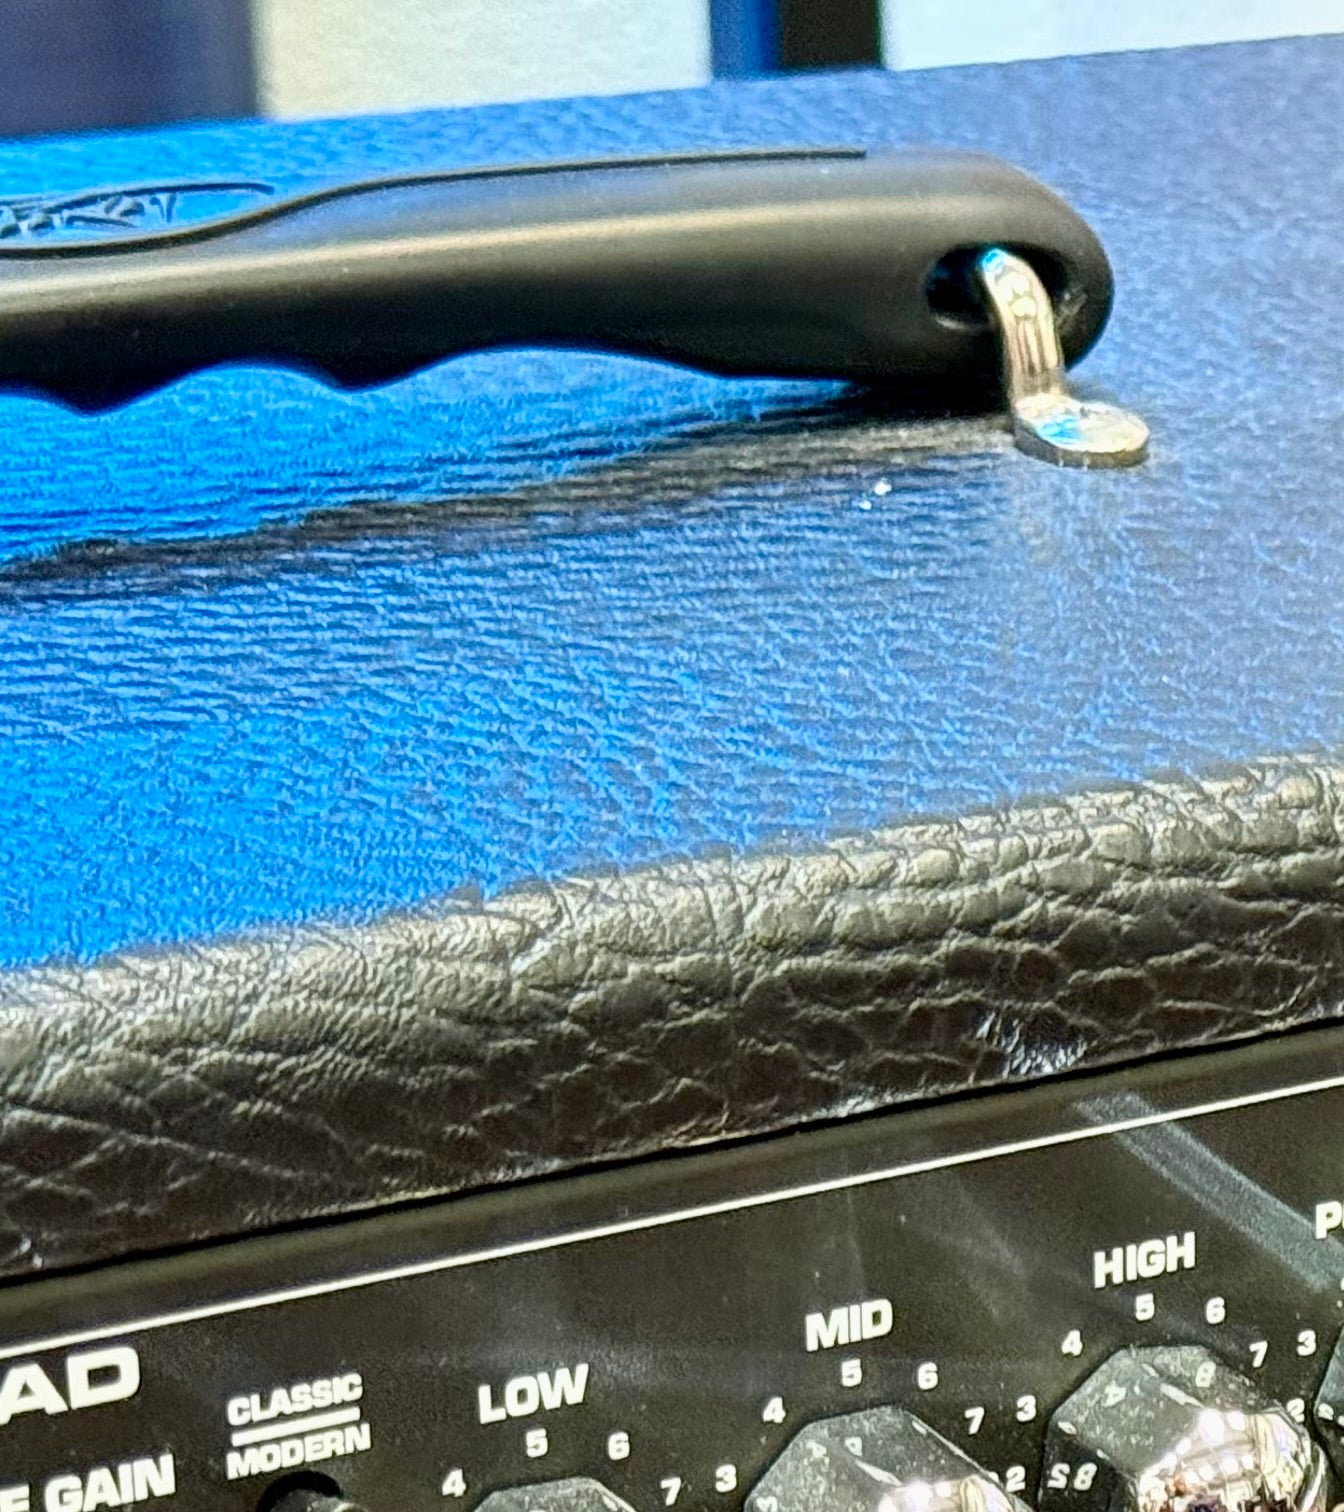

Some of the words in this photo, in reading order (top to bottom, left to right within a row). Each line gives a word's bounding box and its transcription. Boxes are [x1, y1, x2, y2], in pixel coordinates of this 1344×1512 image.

[1093, 1230, 1196, 1288] HIGH
[804, 1298, 893, 1352] MID
[1297, 1329, 1317, 1356] 3
[226, 1372, 363, 1426] CLASSIC
[478, 1362, 589, 1425] LOW
[1006, 1466, 1026, 1492] 2
[1016, 1395, 1037, 1422] 3
[1060, 1329, 1083, 1357] 4
[1134, 1292, 1155, 1320] 5
[1205, 1296, 1225, 1325] 6
[1248, 1341, 1268, 1368] 7
[226, 1423, 372, 1480] MODERN
[715, 1463, 738, 1493] 3
[762, 1396, 787, 1424] 4
[841, 1358, 863, 1388] 5
[916, 1361, 939, 1390] 6
[964, 1406, 985, 1435] 7
[441, 1468, 467, 1498] 4
[525, 1428, 549, 1458] 5
[607, 1431, 630, 1461] 6
[660, 1476, 682, 1507] 7
